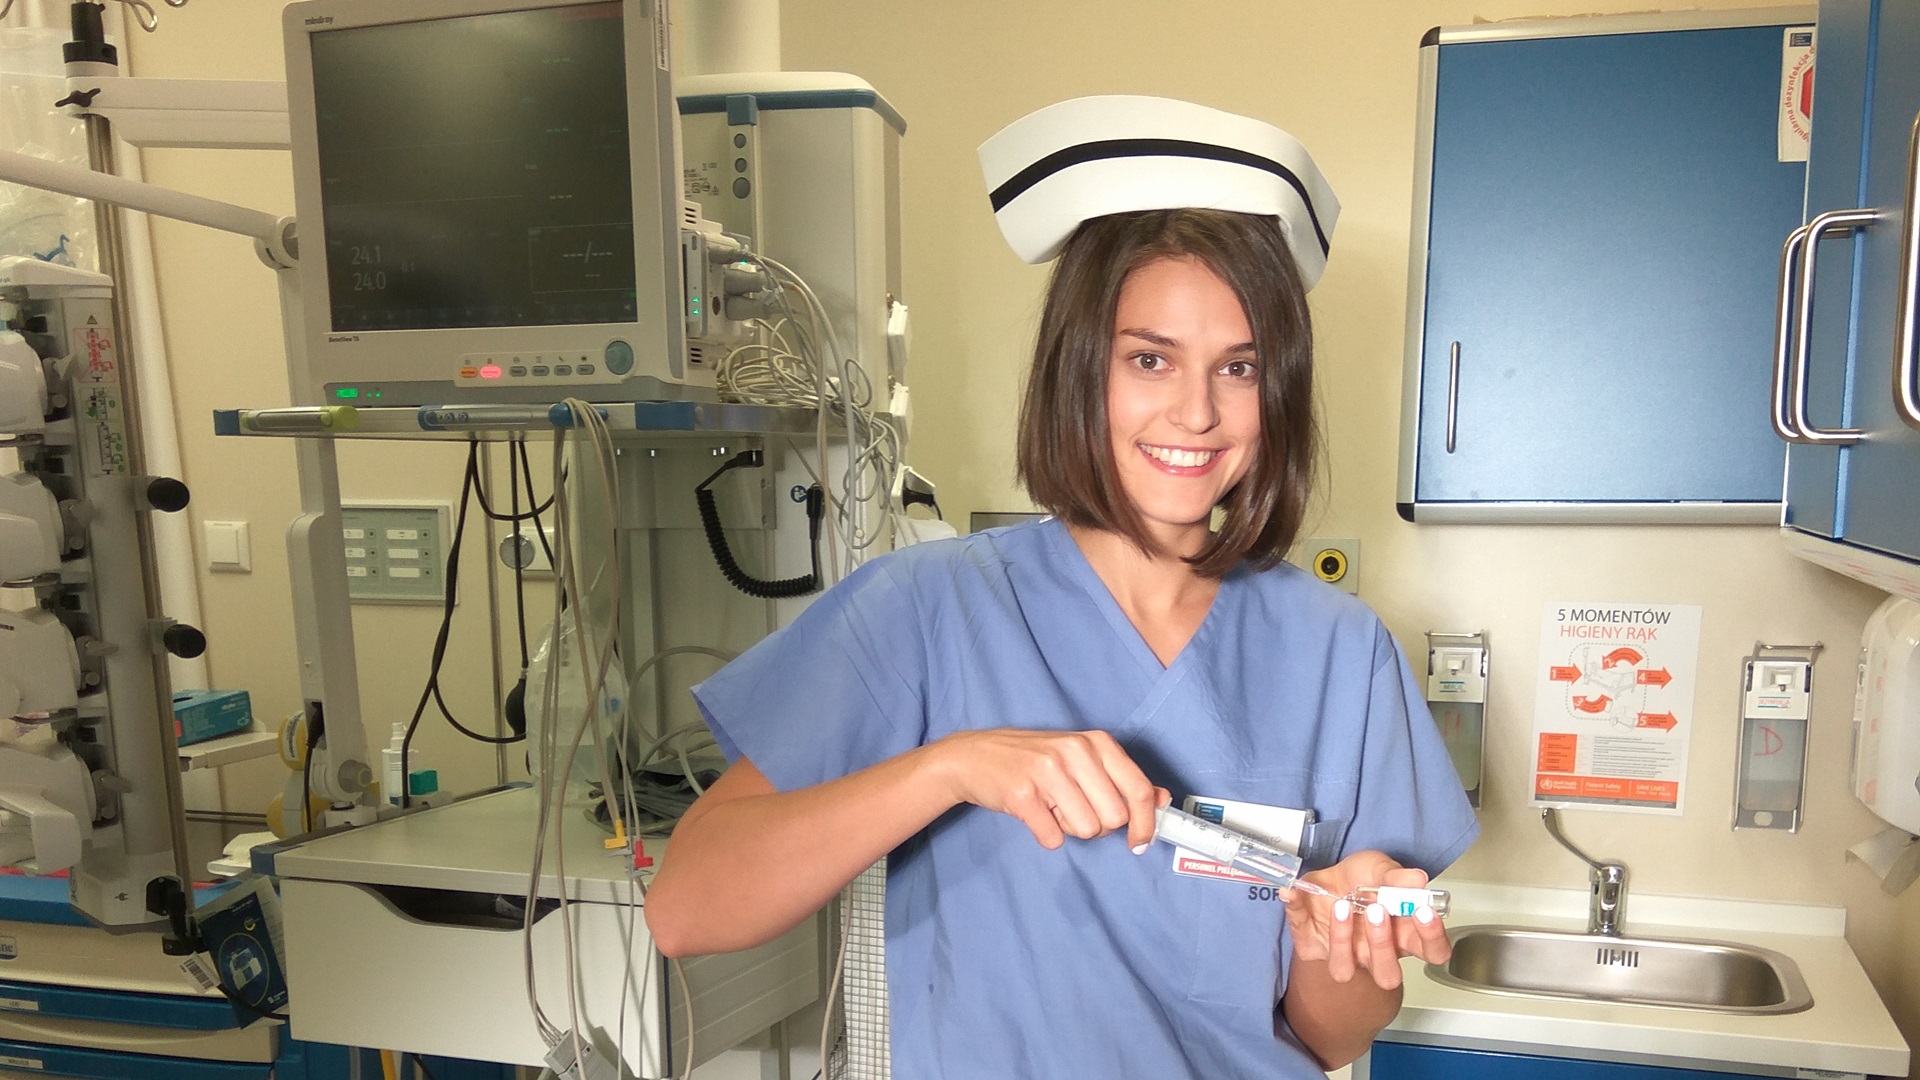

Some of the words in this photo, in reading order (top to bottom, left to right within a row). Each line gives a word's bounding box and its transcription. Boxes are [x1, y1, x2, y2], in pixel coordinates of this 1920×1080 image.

[1788, 109, 1809, 142] gularna
[351, 245, 381, 264] 24.1
[353, 271, 386, 290] 24.0
[1557, 608, 1566, 622] 5
[1570, 608, 1671, 625] MOMENTÓW
[1560, 624, 1623, 639] HIGIENY
[1626, 626, 1658, 643] RĄK
[1604, 658, 1614, 668] 2
[1551, 669, 1557, 679] 1
[1638, 672, 1646, 682] 4
[1575, 697, 1583, 707] 3
[1639, 716, 1647, 726] 5
[1753, 725, 1784, 756] D
[1183, 861, 1216, 873] PERSONEL
